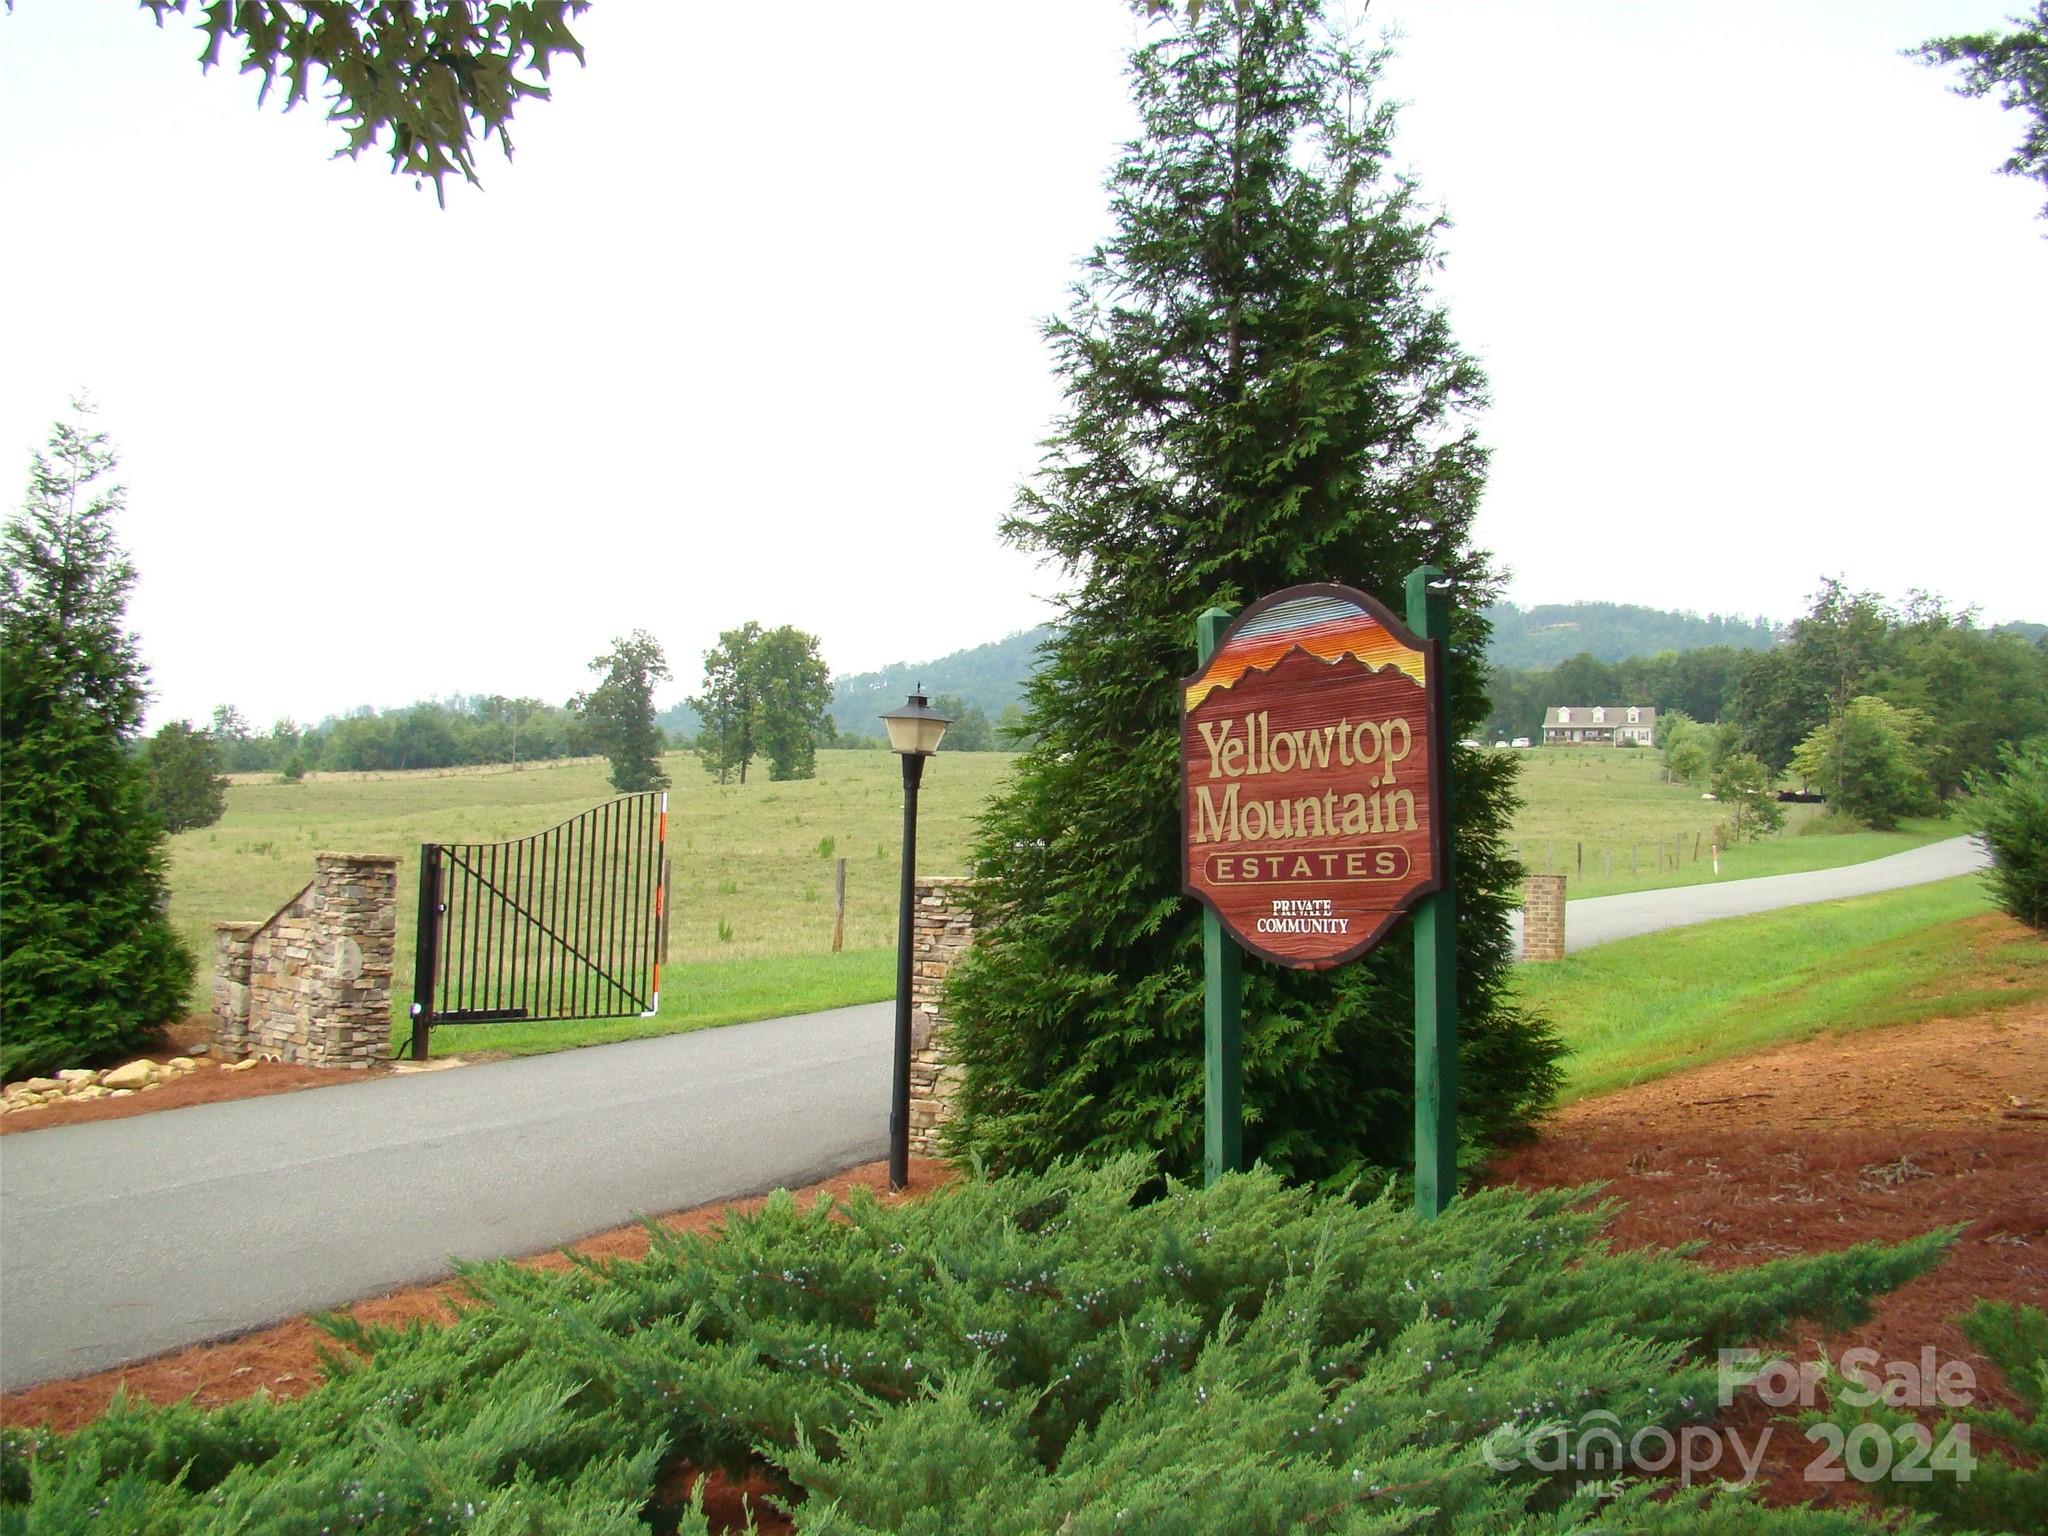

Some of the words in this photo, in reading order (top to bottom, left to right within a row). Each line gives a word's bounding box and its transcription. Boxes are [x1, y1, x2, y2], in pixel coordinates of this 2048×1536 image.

[1198, 711, 1412, 785] Yellowtop
[1195, 776, 1419, 843] Mountain
[1217, 851, 1396, 880] ESTATES
[1272, 899, 1333, 917] PRIVATE
[1256, 917, 1349, 934] COMMUNITY
